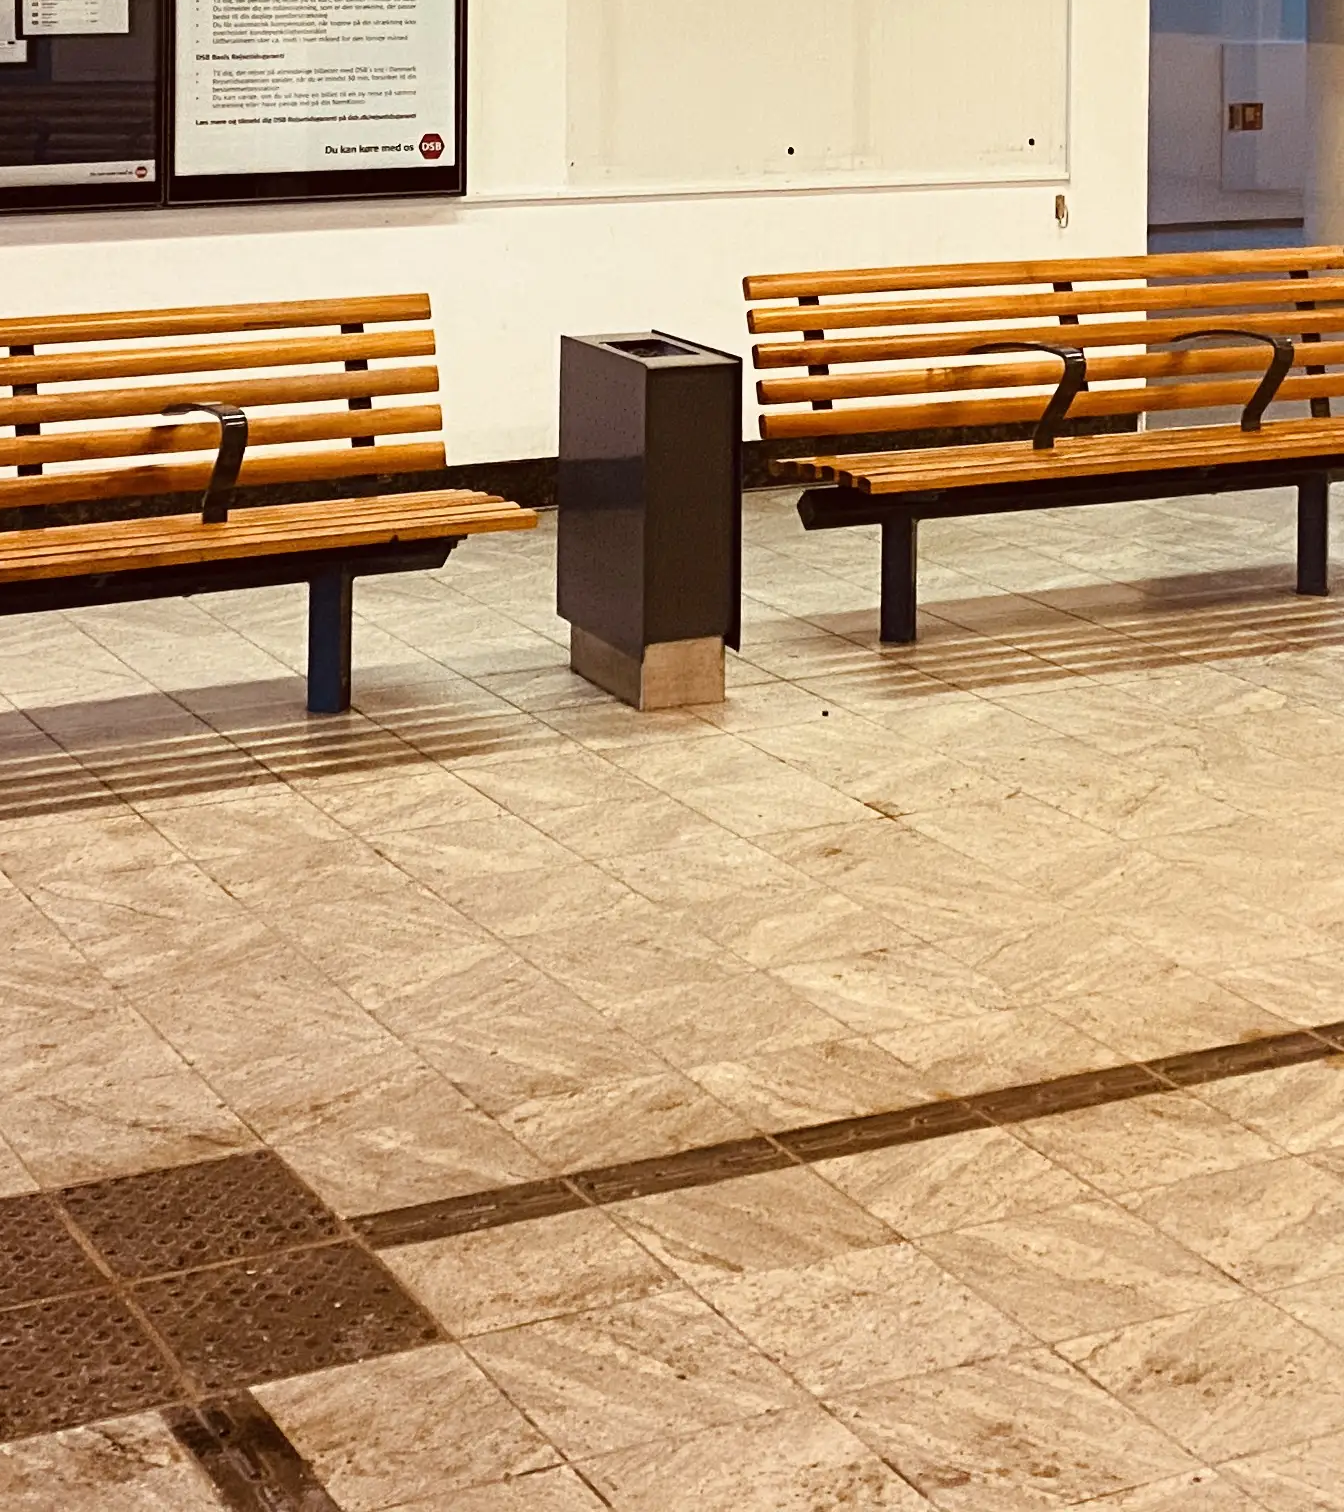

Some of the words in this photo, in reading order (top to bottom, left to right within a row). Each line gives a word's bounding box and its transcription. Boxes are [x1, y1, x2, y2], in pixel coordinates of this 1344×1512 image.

[325, 145, 338, 154] Du
[340, 144, 357, 154] kan
[381, 143, 402, 153] med
[403, 144, 415, 153] os
[422, 142, 442, 151] DSB
